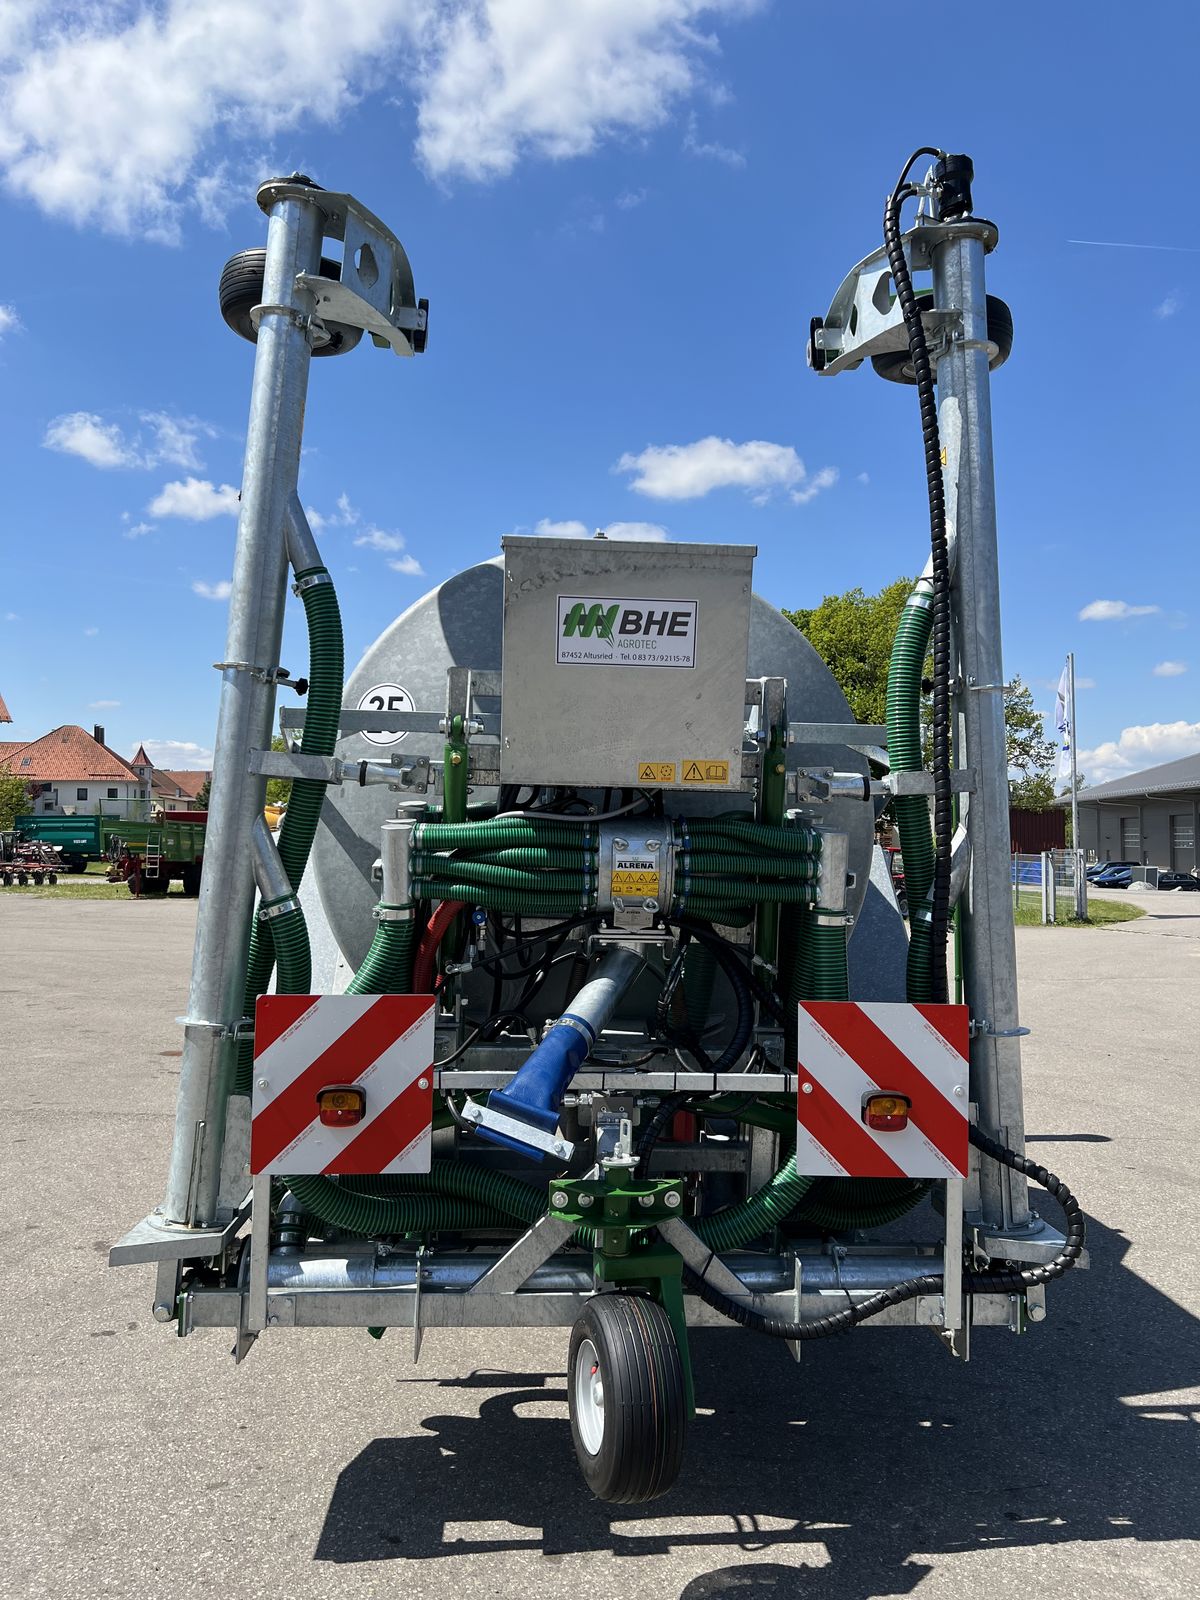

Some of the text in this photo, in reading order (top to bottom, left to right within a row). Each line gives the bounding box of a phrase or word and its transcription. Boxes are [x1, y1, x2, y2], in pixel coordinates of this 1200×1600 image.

[618, 610, 692, 636] BHE
[617, 639, 658, 650] AGROTEC
[561, 651, 583, 659] 87452
[583, 651, 613, 660] Altusried
[621, 653, 631, 661] Tel.
